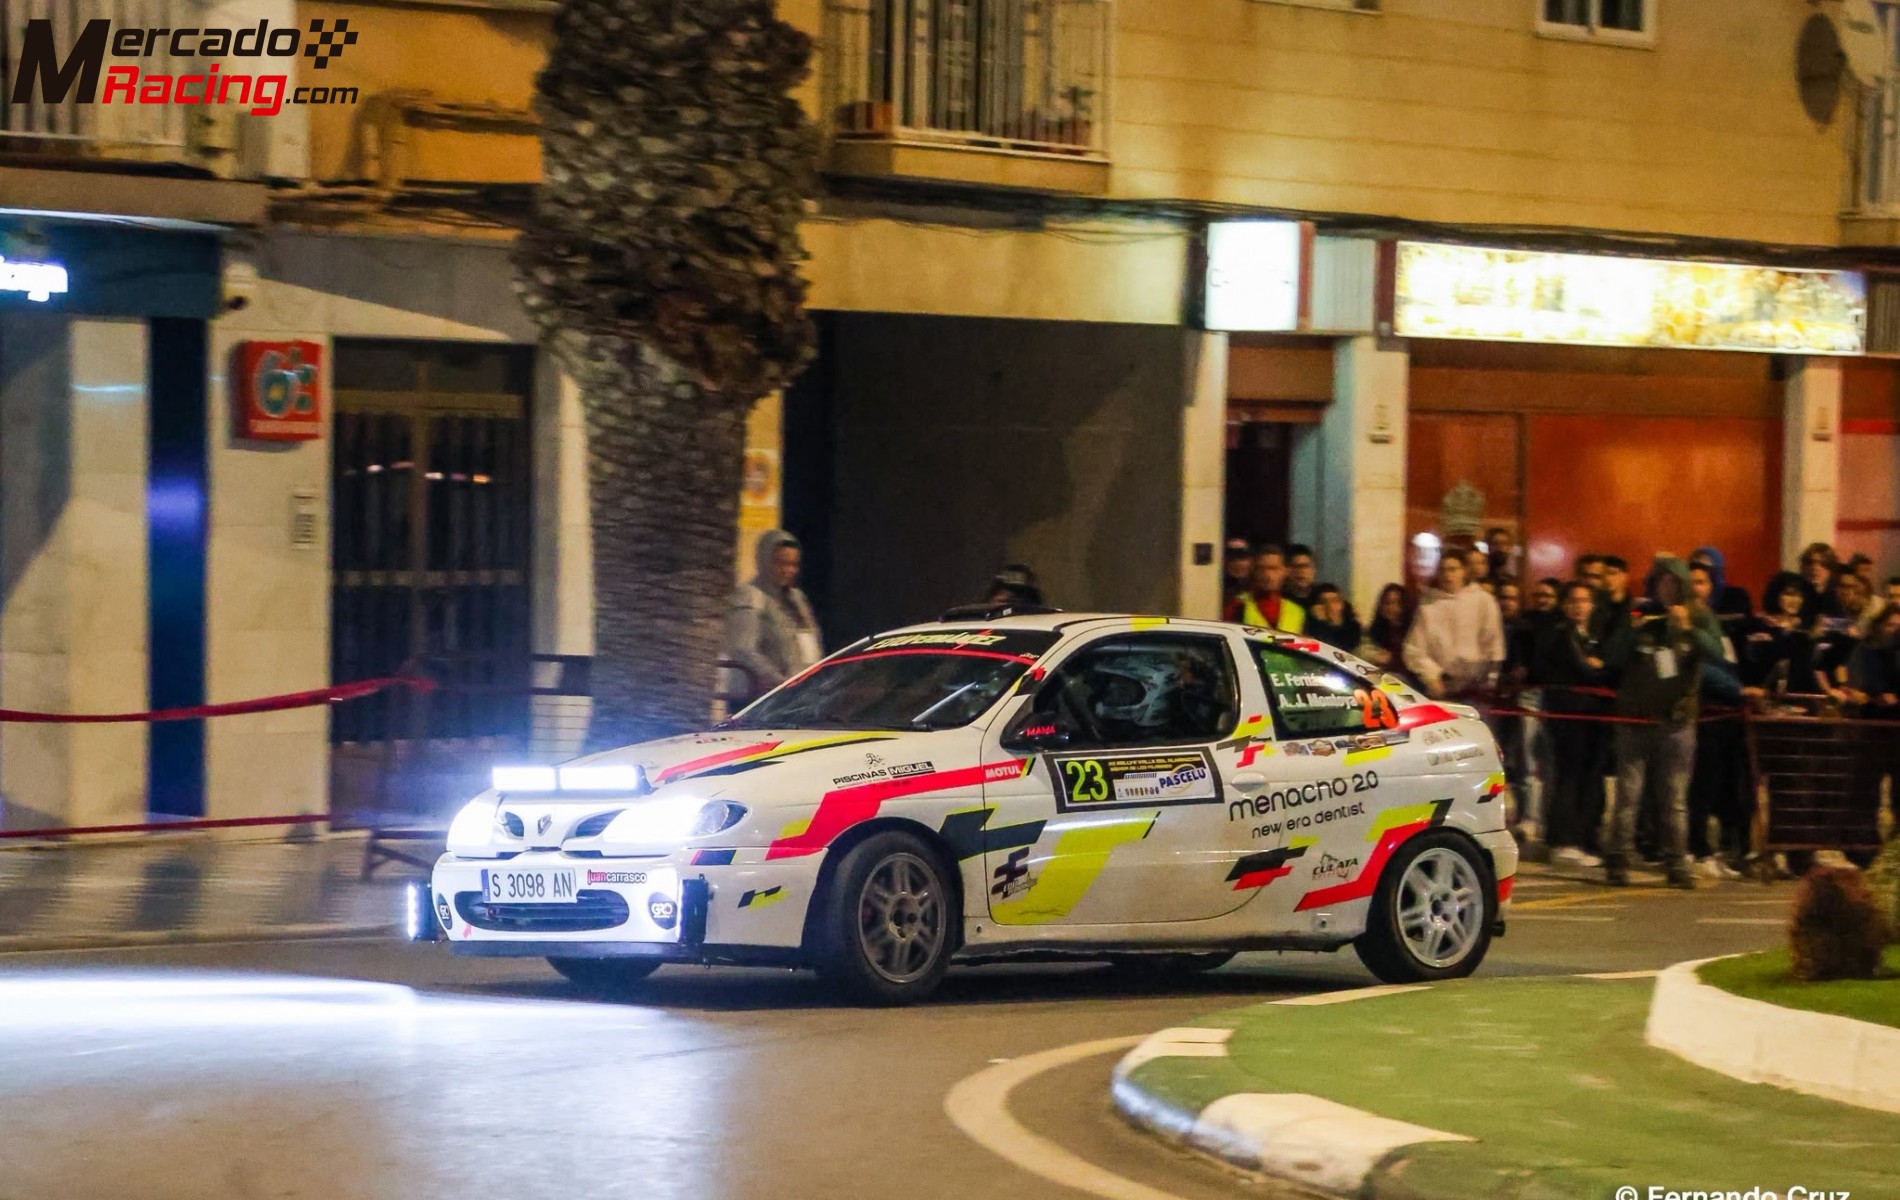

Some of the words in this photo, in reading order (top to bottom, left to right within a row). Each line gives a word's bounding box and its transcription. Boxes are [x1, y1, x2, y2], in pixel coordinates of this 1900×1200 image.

[1270, 674, 1284, 687] E.
[1354, 689, 1398, 729] 23
[832, 769, 887, 785] PISCINAS
[887, 761, 935, 776] MIGUEL
[984, 764, 1021, 779] MOTUL
[1065, 760, 1109, 801] 23
[1159, 768, 1207, 789] PASCELU
[1229, 777, 1348, 822] menacho
[1252, 822, 1283, 839] new
[1286, 816, 1311, 831] era
[1314, 802, 1365, 824] dentist
[491, 873, 502, 898] S
[507, 873, 546, 898] 3098
[553, 872, 573, 898] AN
[587, 869, 648, 885] juancarrasco
